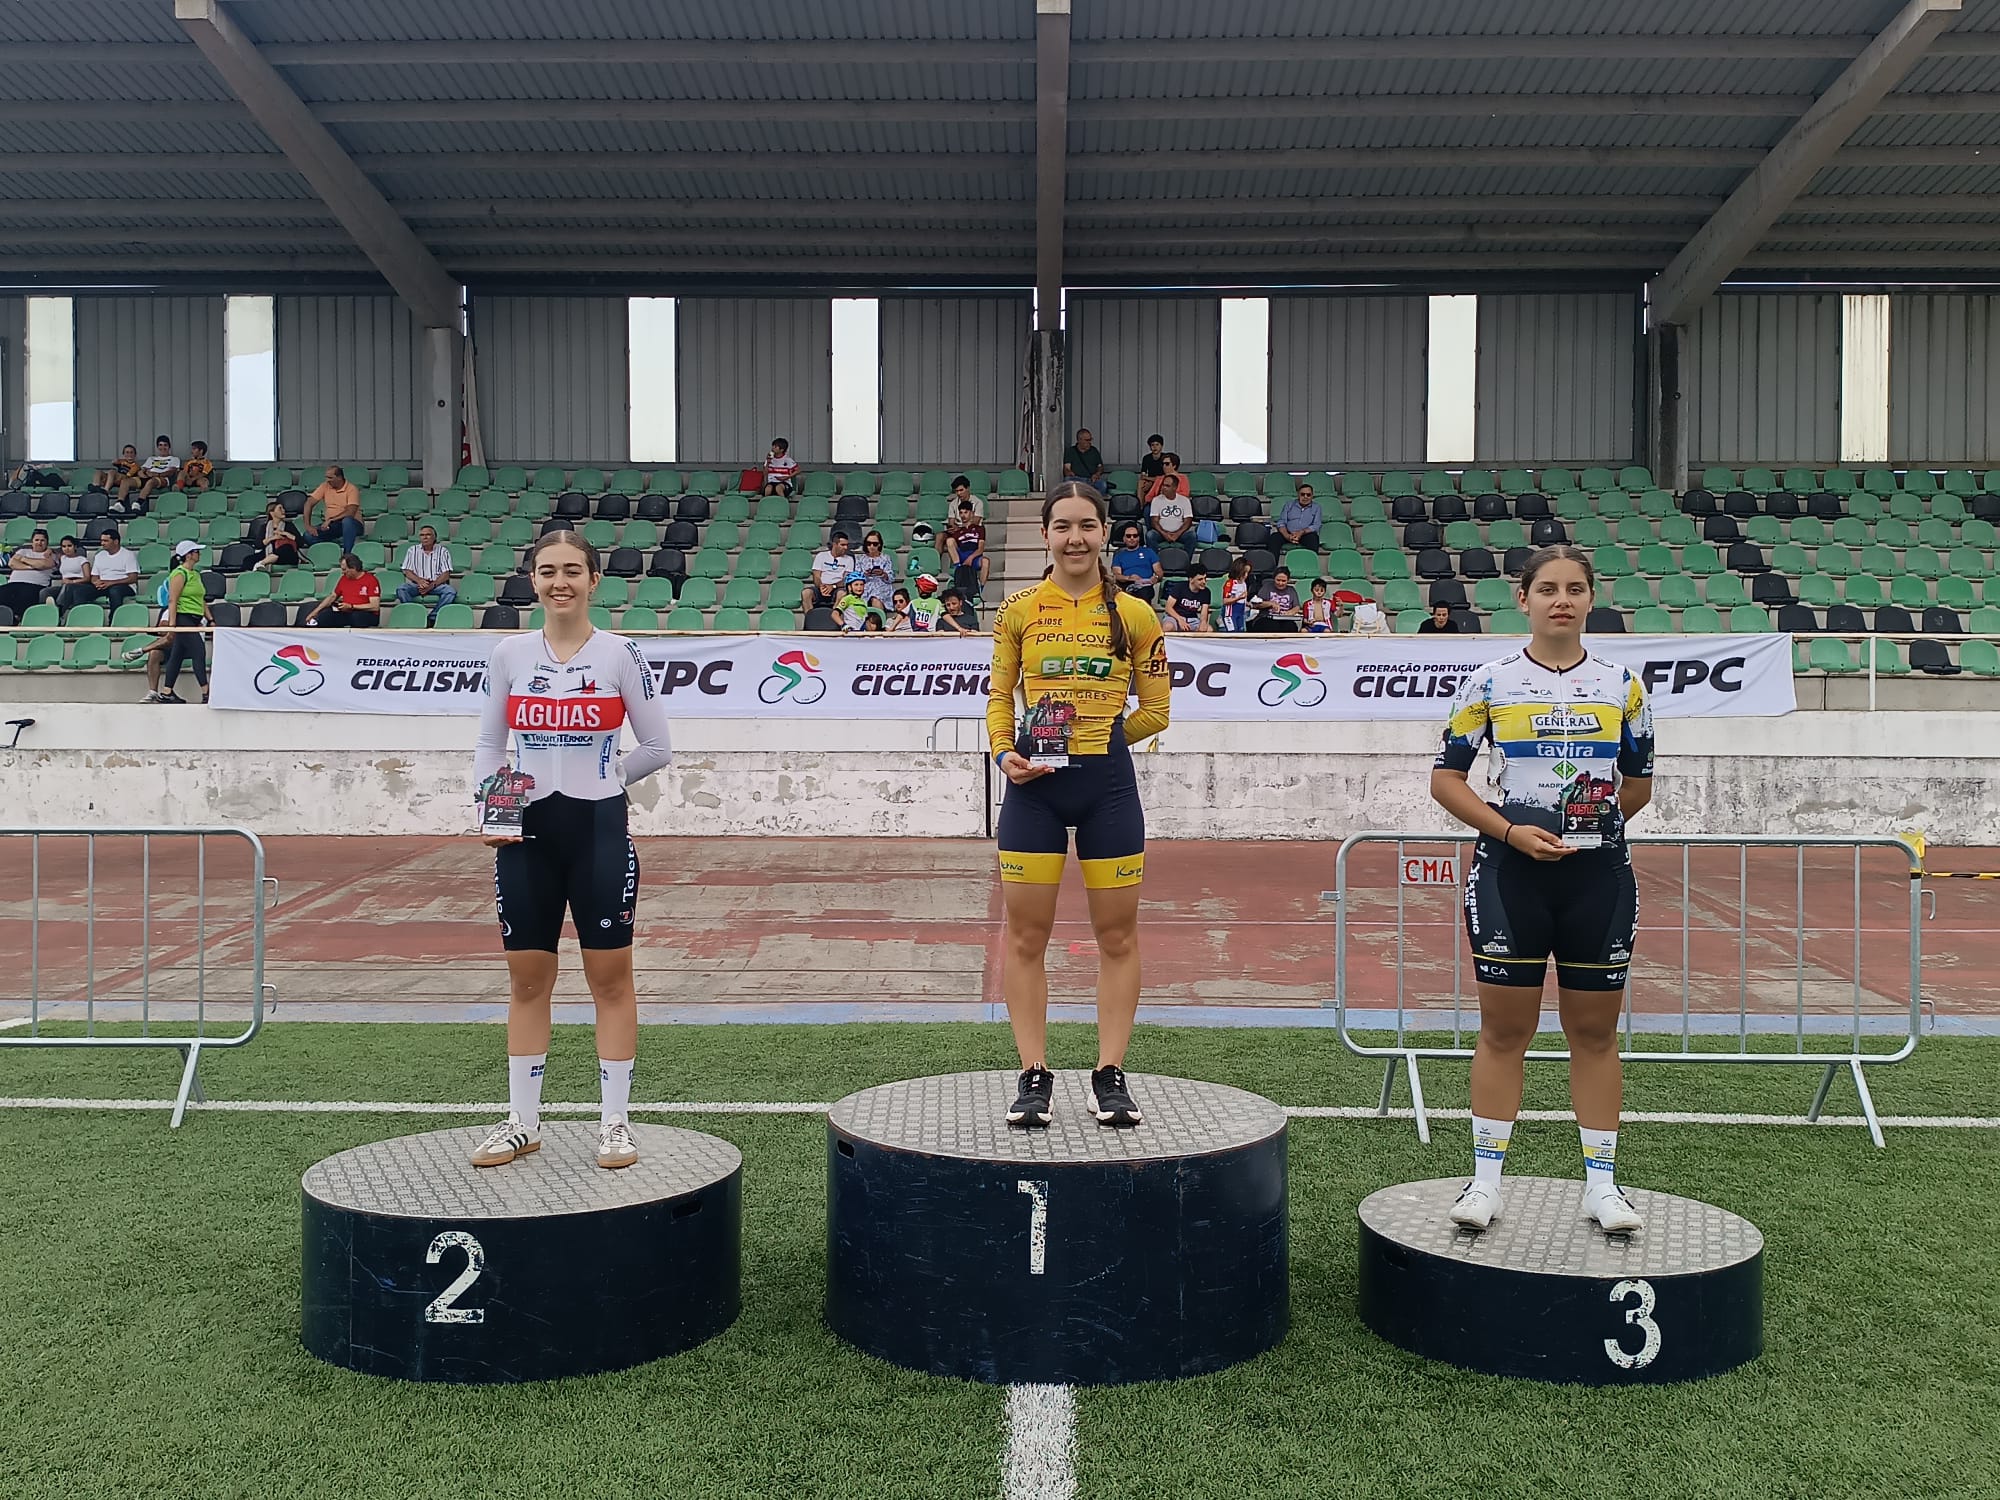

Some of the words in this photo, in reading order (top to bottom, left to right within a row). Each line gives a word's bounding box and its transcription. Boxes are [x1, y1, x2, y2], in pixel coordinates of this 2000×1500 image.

[356, 657, 420, 669] FEDERAÇÃO
[422, 660, 489, 668] PORTUGUES
[855, 662, 918, 673] FEDERAÇÃO
[920, 663, 991, 671] PORTUGUESA
[1042, 659, 1111, 676] BKT
[1356, 663, 1421, 674] FEDERAÇÃO
[1423, 664, 1483, 672] PORTUGU
[351, 669, 488, 693] CICLISM
[1642, 657, 1746, 694] FPC
[1353, 675, 1469, 698] CICLIS
[515, 699, 600, 727] ÁGUIAS
[1535, 716, 1595, 727] GENERAL
[1536, 742, 1594, 757] tavira
[487, 807, 503, 821] 2º
[1568, 817, 1582, 830] 3º
[1405, 859, 1454, 883] CMA
[1491, 966, 1508, 976] CA
[1017, 1180, 1048, 1275] 1
[425, 1230, 485, 1323] 2
[1603, 1279, 1662, 1369] 3
